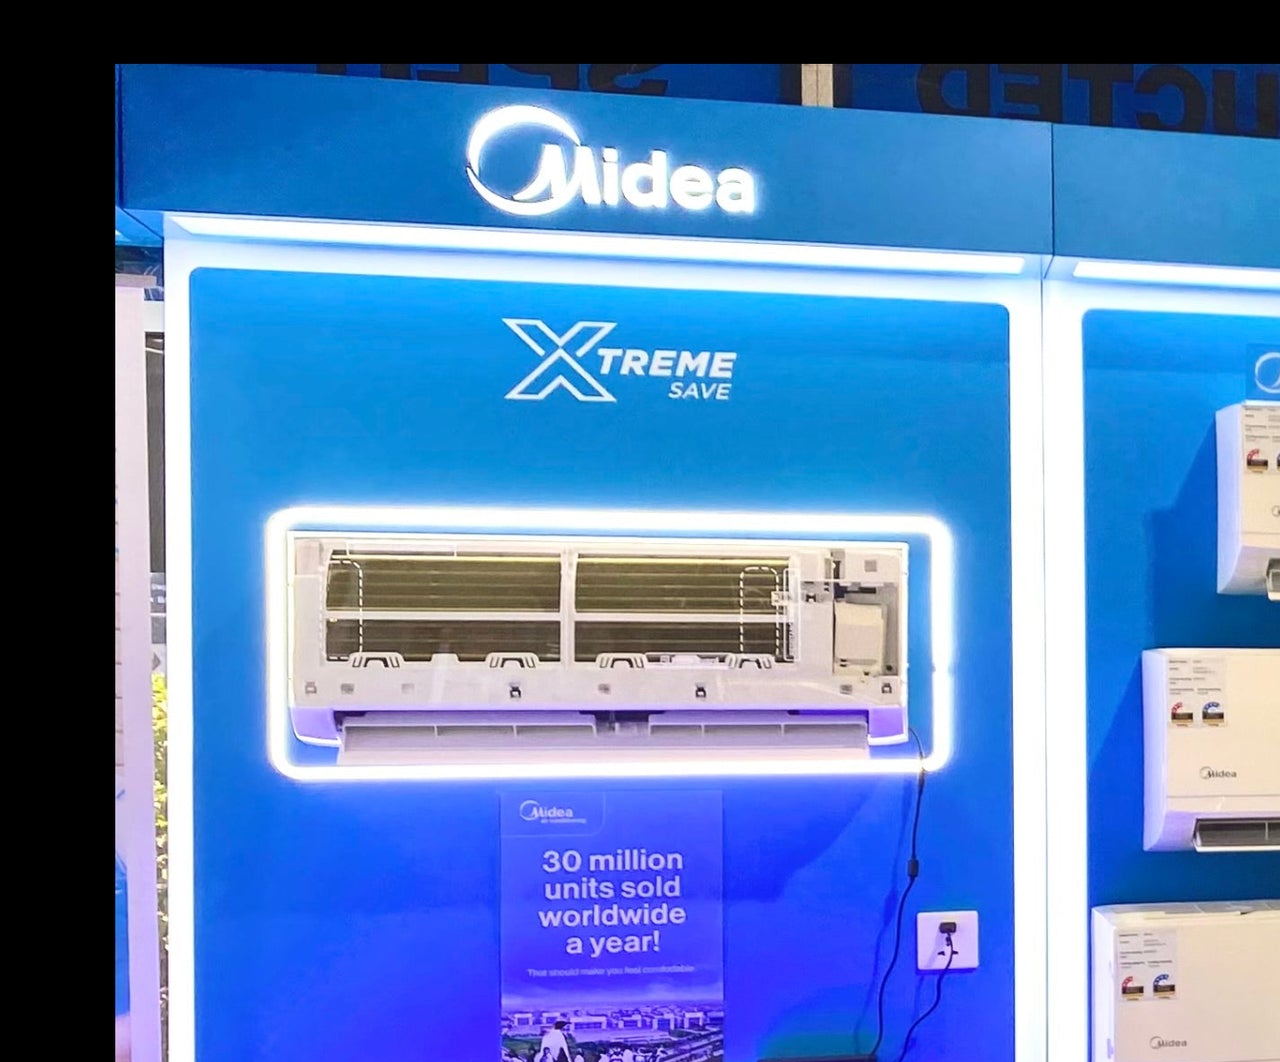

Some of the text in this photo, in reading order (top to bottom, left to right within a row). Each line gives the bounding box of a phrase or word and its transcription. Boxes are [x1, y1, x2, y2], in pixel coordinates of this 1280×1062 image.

[466, 104, 760, 216] Midea
[668, 381, 732, 401] SAVE
[1199, 766, 1238, 780] Midea
[519, 799, 574, 821] Midea
[541, 848, 684, 873] 30 million
[543, 874, 682, 900] units sold
[537, 902, 688, 928] worldwide
[565, 930, 661, 958] a year!
[1149, 1035, 1188, 1050] Midea
